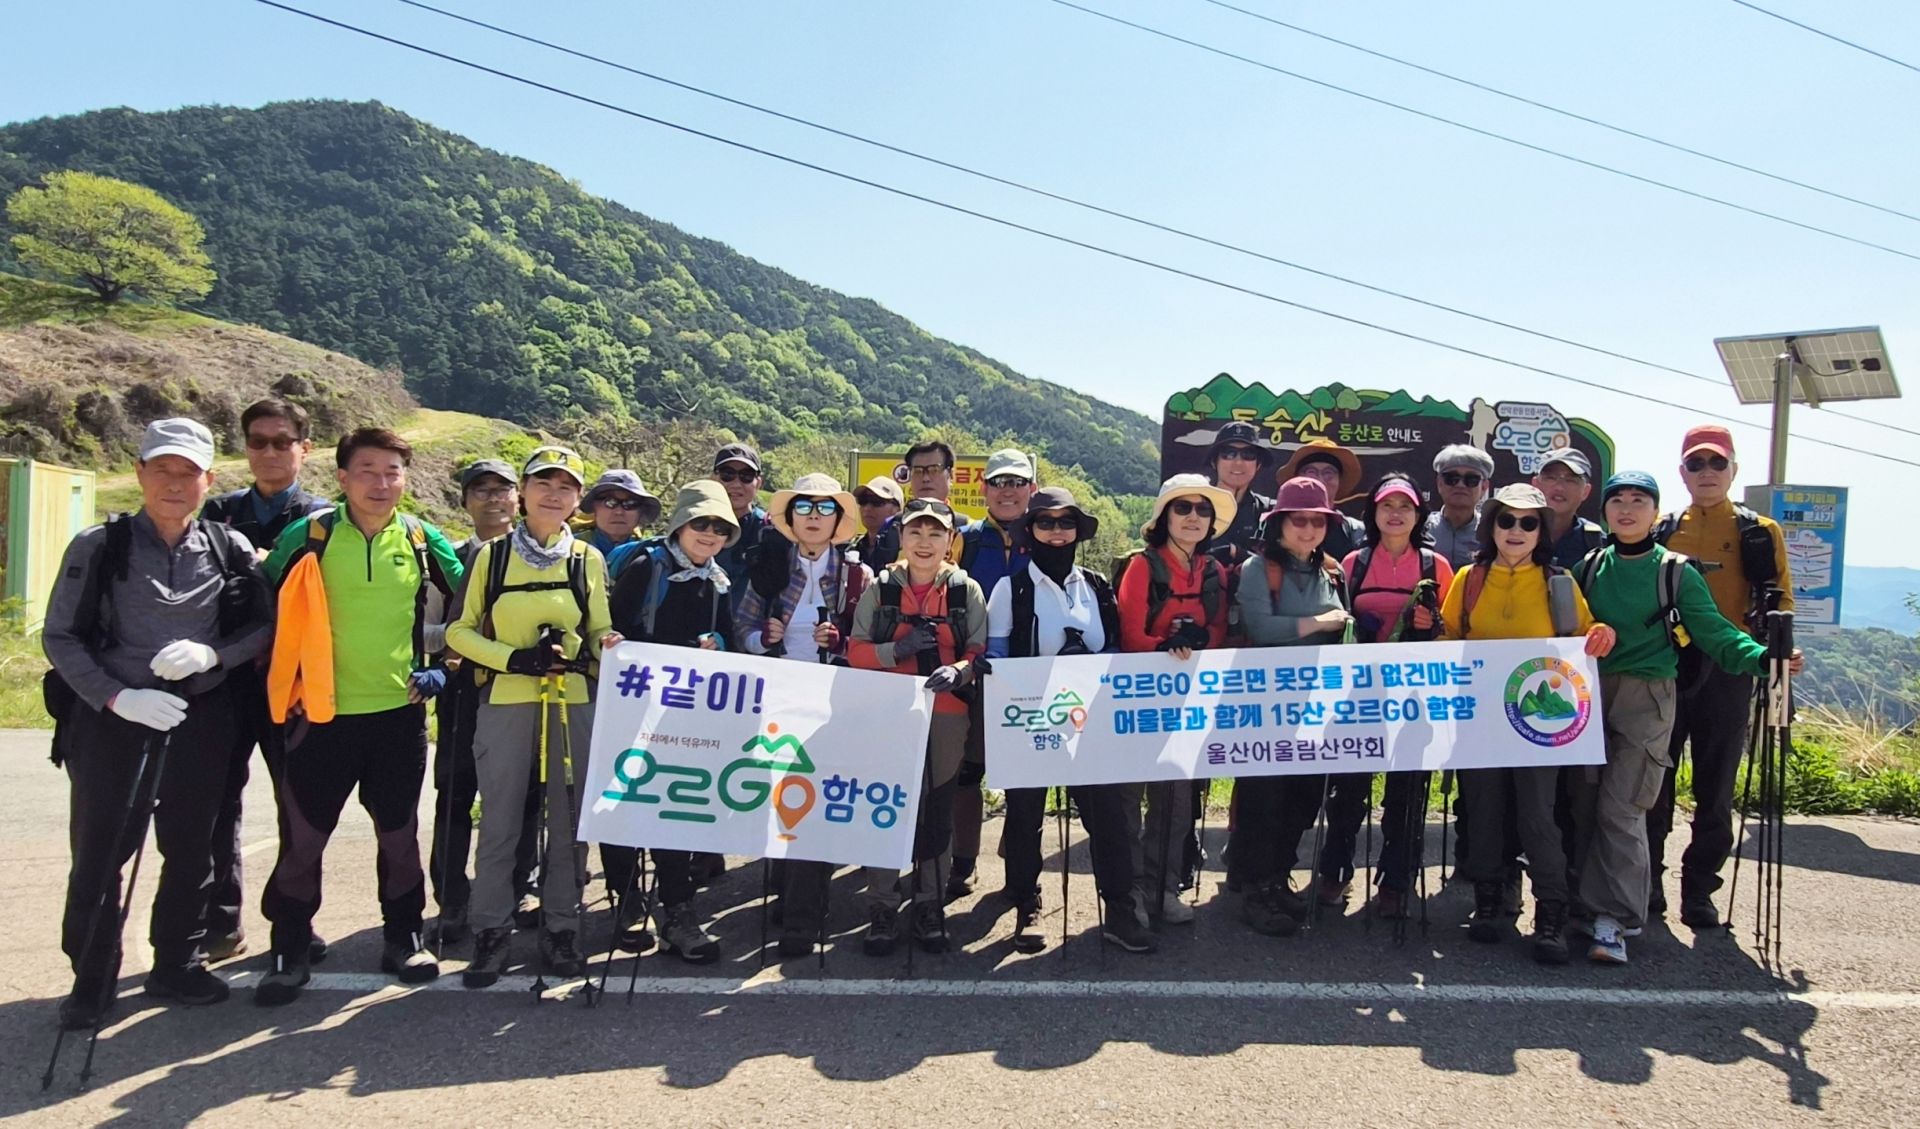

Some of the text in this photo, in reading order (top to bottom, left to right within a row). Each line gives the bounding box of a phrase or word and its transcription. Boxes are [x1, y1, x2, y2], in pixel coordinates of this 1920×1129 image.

[1338, 424, 1384, 442] 등산로
[1387, 428, 1423, 443] 안내도
[615, 663, 765, 714] #같이!
[1199, 668, 1266, 694] 오르면
[1274, 666, 1343, 692] 못오를
[1351, 664, 1372, 689] 리
[1114, 696, 1477, 734] 어울림과 함께 15산 오르GO 함양
[640, 732, 720, 750] 지리에서 덕유까지
[1033, 733, 1062, 750] 함양
[1207, 736, 1385, 764] 울산어울림산악회
[822, 774, 907, 829] 함양
